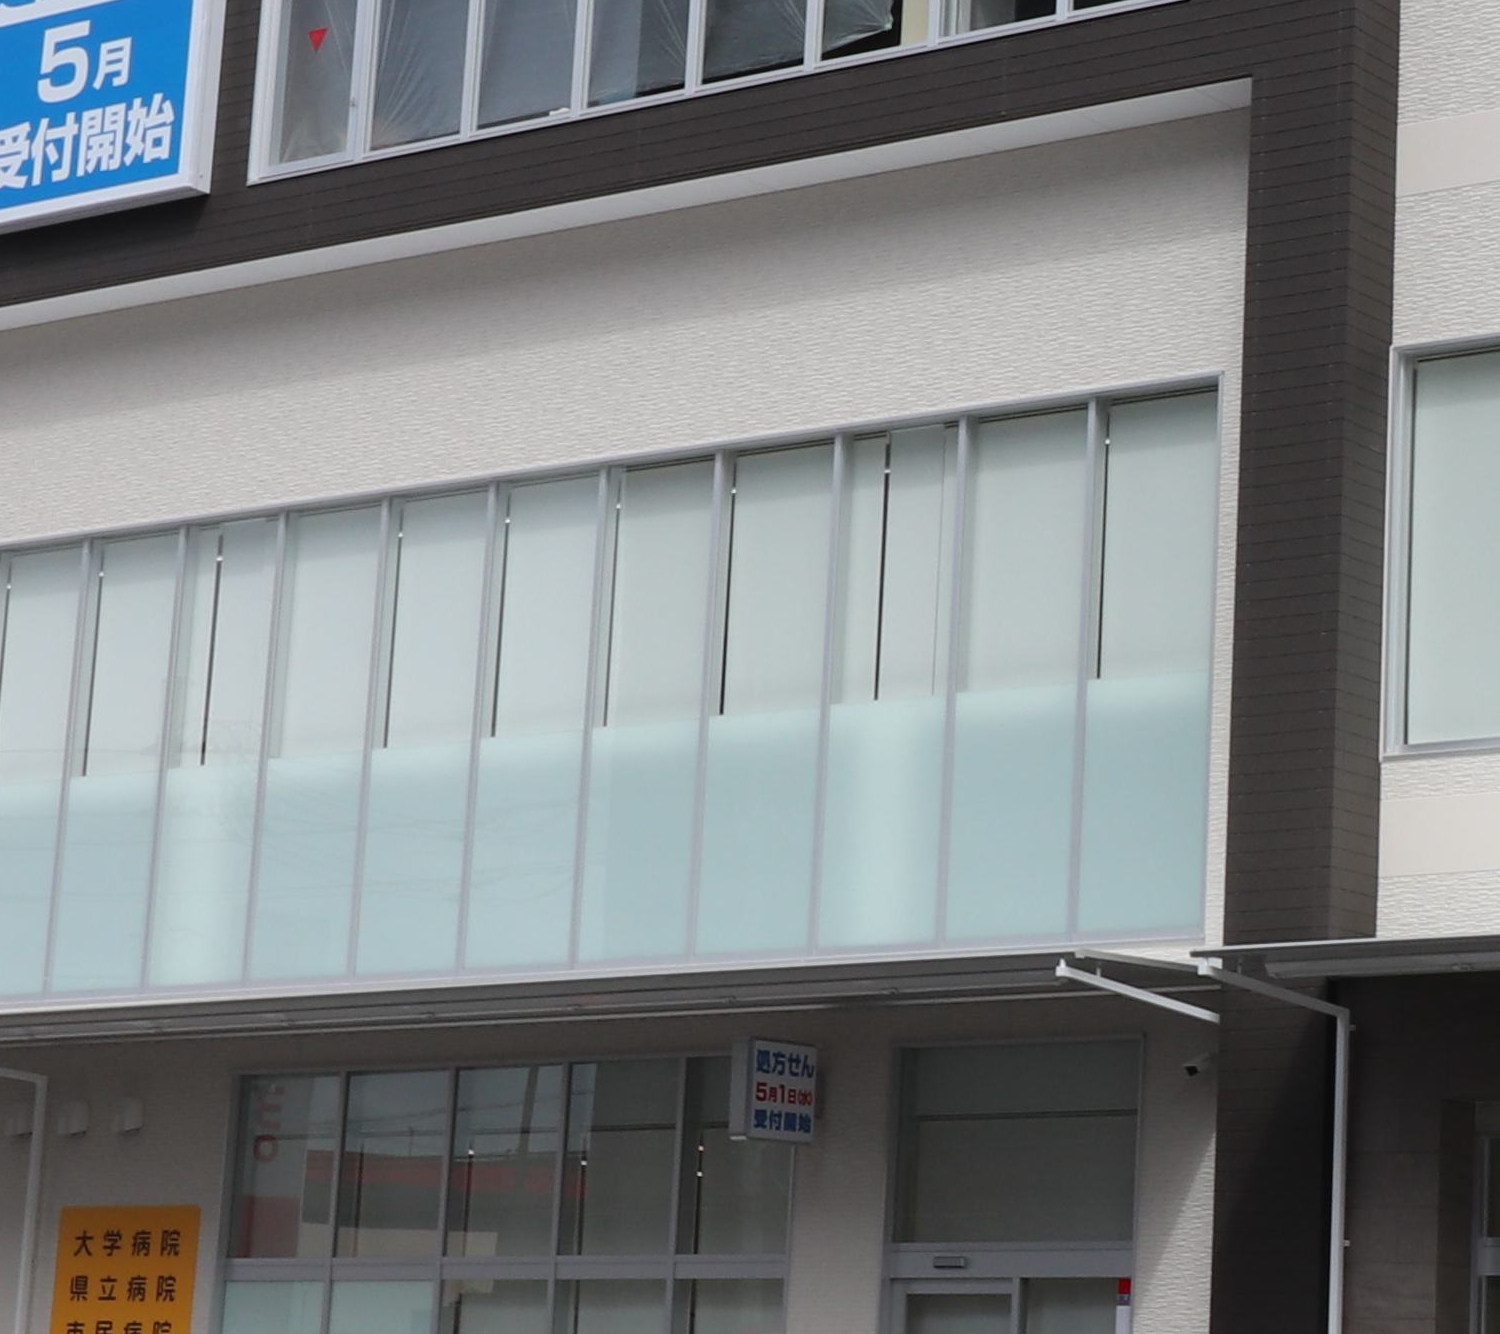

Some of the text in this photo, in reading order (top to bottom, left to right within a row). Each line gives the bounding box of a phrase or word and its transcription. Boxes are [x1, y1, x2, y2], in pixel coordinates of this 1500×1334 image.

[37, 19, 132, 105] 5月
[756, 1050, 815, 1078] 処方せん
[756, 1082, 814, 1106] 5月1日(水)
[754, 1109, 811, 1133] 受付開始
[74, 1229, 181, 1257] 大学病院
[70, 1275, 177, 1302] 県立病院
